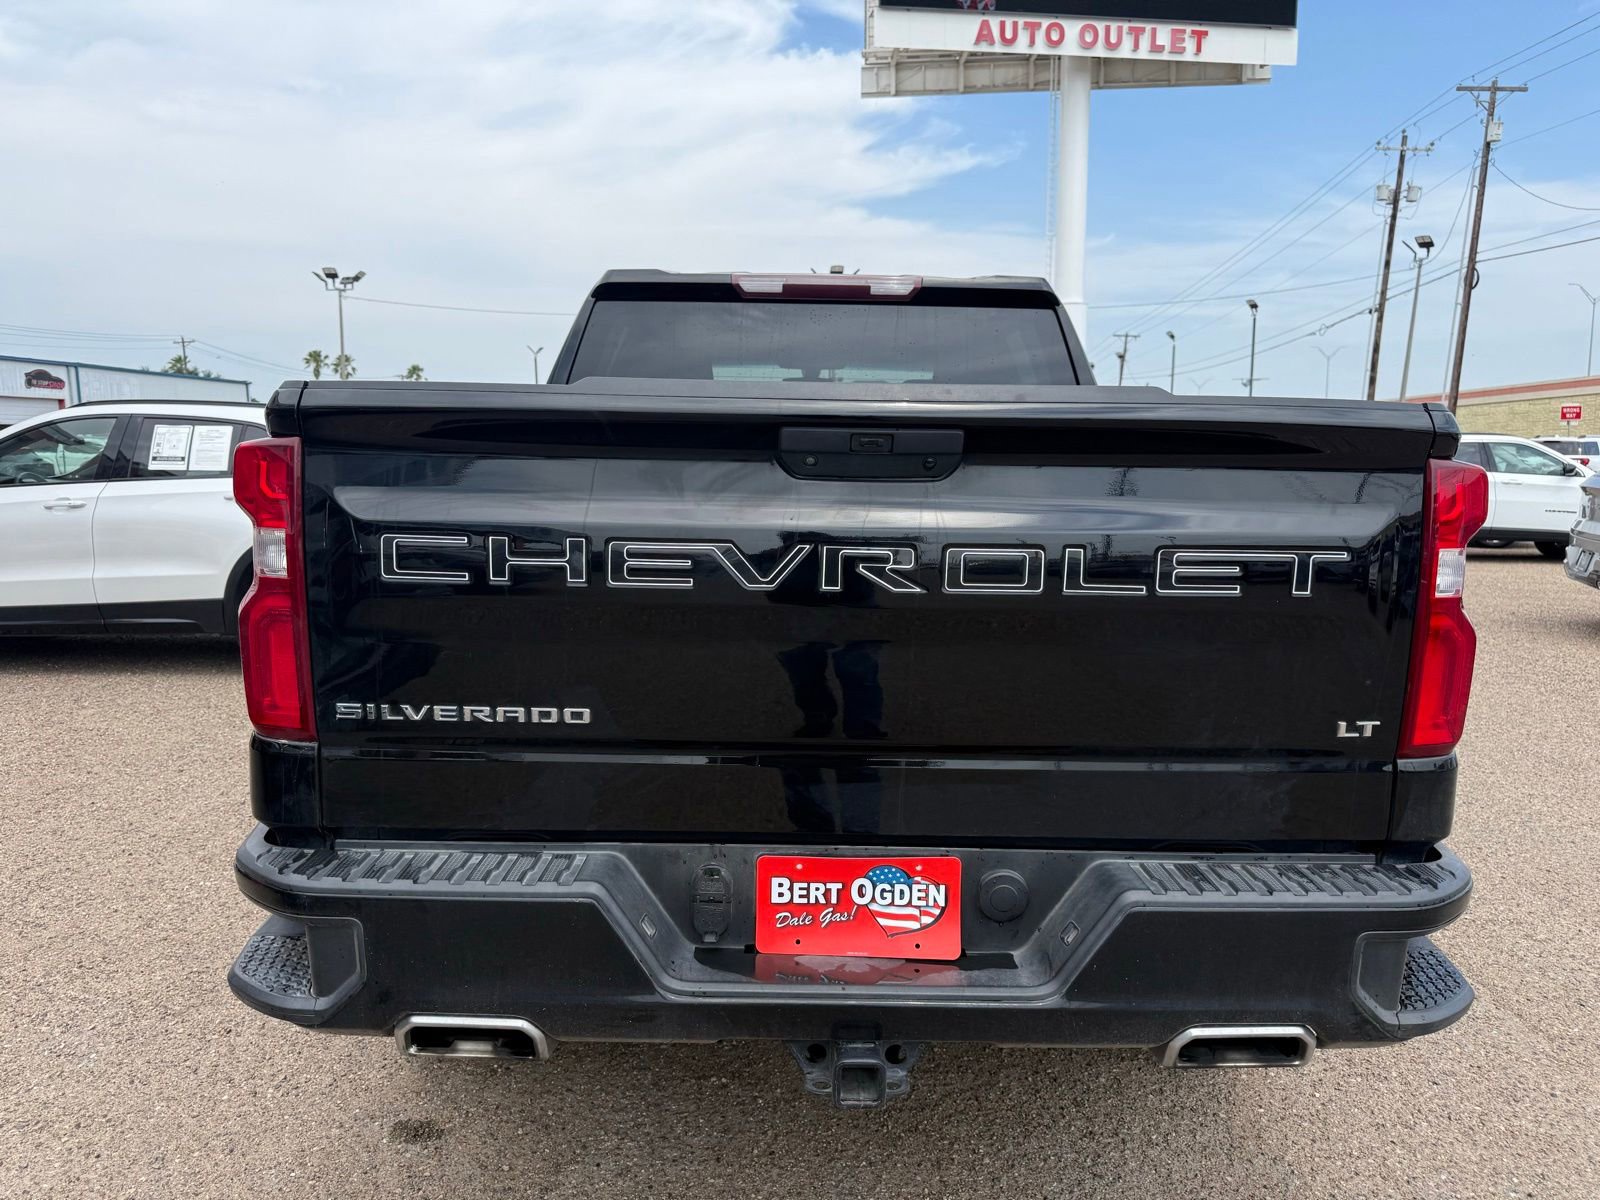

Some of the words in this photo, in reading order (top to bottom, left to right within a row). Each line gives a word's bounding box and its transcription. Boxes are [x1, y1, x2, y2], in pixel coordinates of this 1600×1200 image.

[974, 18, 1066, 48] AUTO
[1078, 23, 1209, 55] OUTLET
[379, 533, 1349, 597] CHEVROLET
[335, 702, 592, 724] SILVERADO
[1336, 720, 1381, 738] LT
[770, 876, 843, 904] BERT
[850, 877, 947, 908] OGDEN
[775, 911, 814, 928] Dale
[819, 905, 857, 928] Gas!
